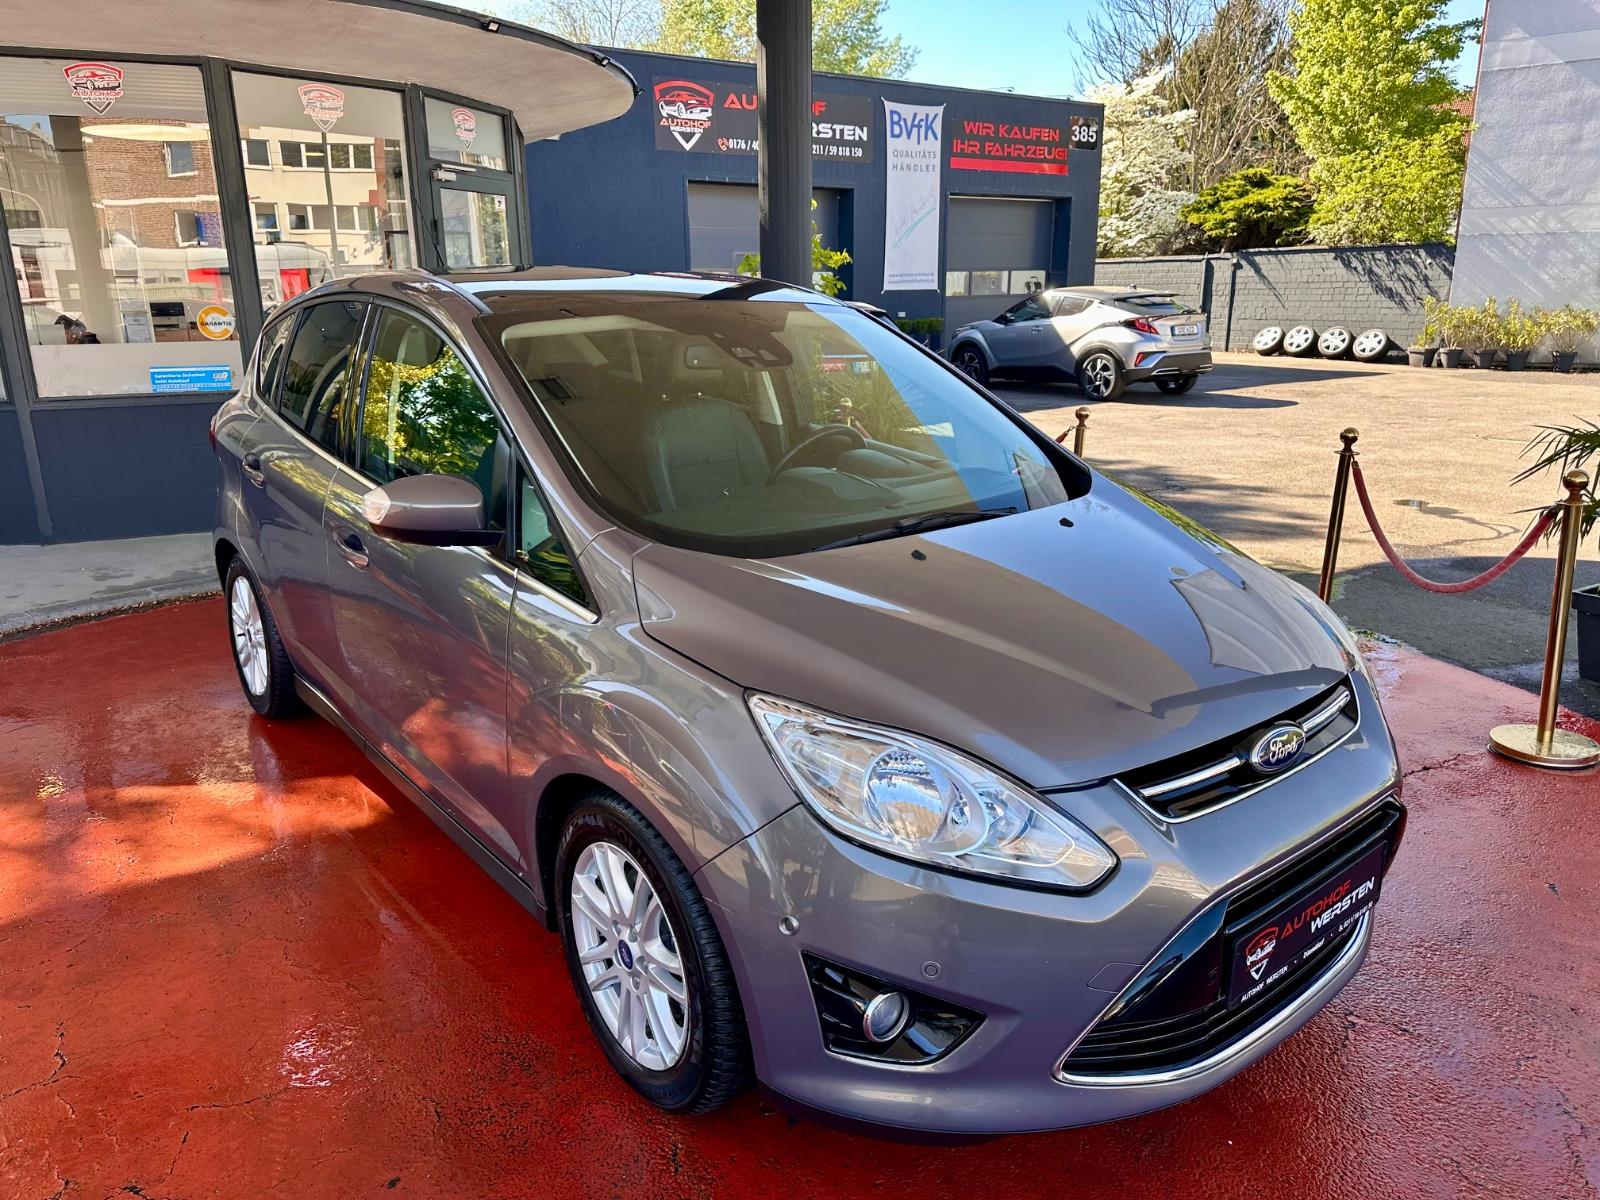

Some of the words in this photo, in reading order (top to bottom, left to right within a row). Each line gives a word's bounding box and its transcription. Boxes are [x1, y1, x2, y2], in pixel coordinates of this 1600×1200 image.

[660, 118, 712, 128] AUTOHOF
[811, 122, 868, 141] RSTEN
[963, 121, 995, 136] WIR
[999, 124, 1060, 141] KAUFEN
[1071, 125, 1097, 143] 385
[728, 138, 745, 150] 0176
[952, 139, 980, 155] IHR
[892, 149, 937, 159] QUALITÄTS
[892, 162, 937, 172] HÄNDLER
[1270, 733, 1300, 763] Ford
[1281, 879, 1352, 940] AUTOHOF
[1311, 876, 1375, 934] WERSTEN
